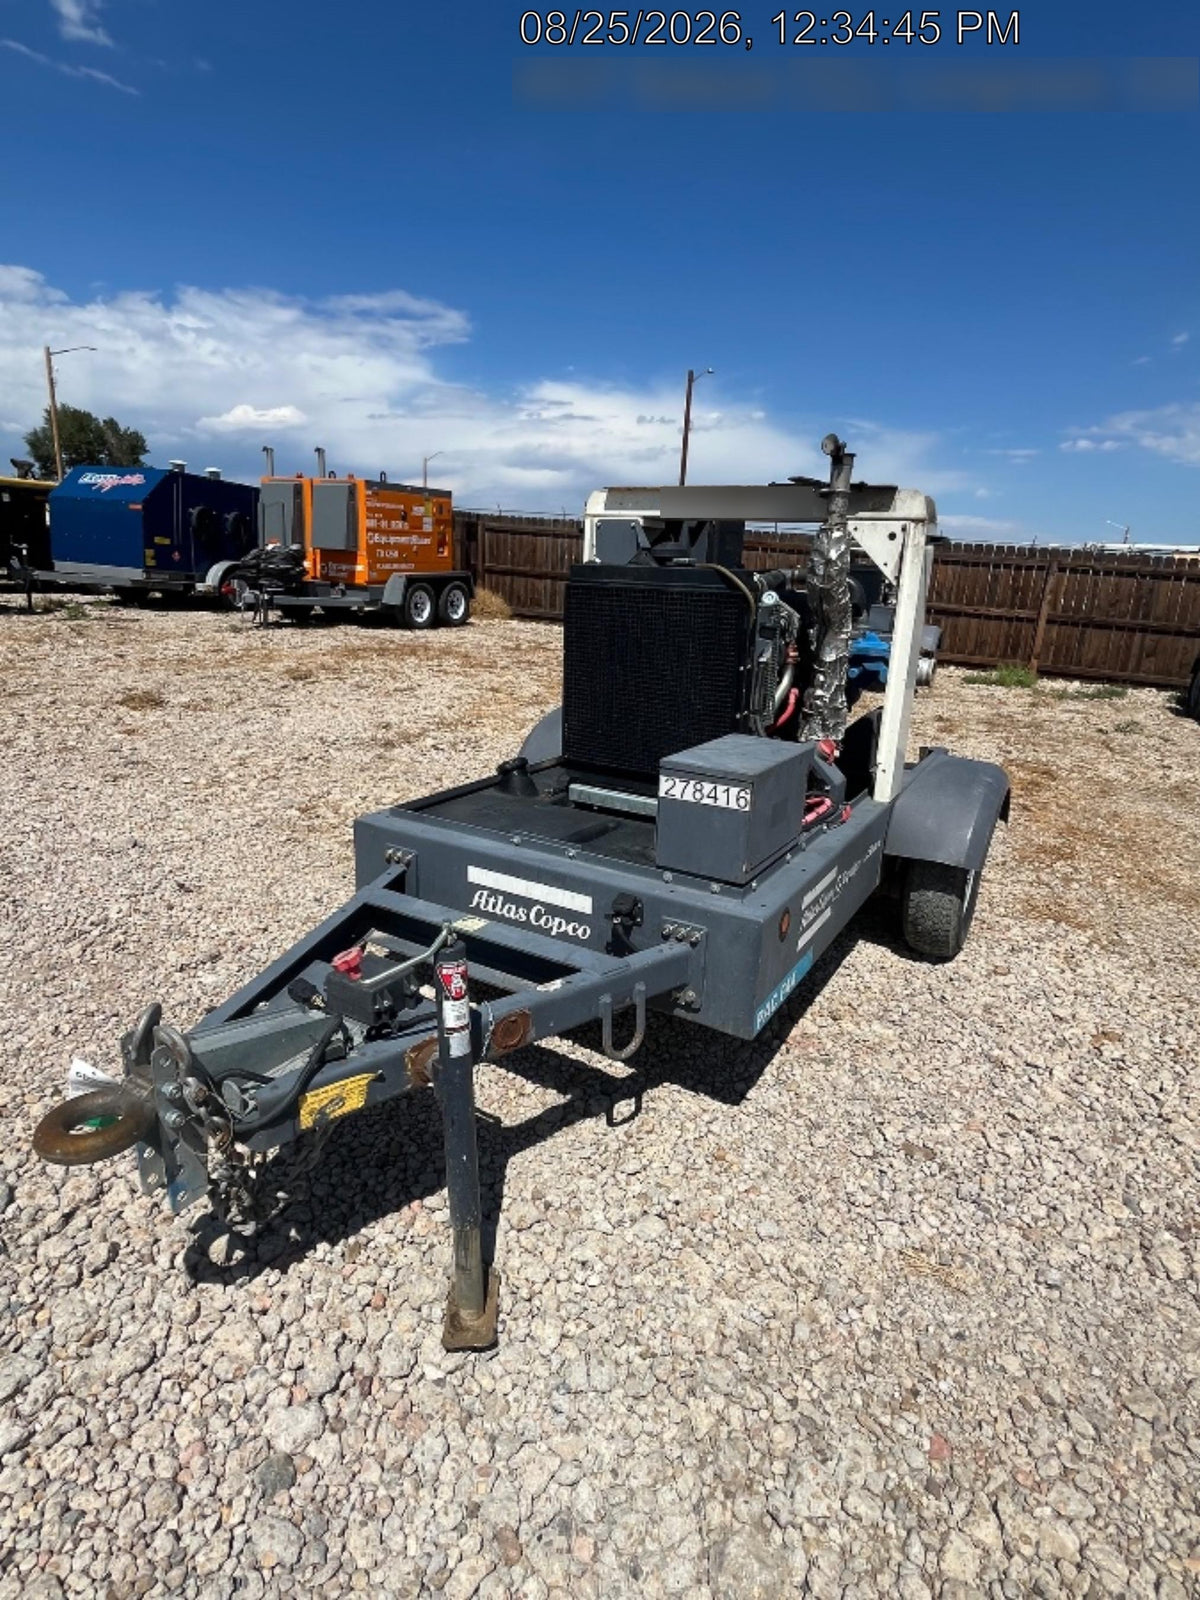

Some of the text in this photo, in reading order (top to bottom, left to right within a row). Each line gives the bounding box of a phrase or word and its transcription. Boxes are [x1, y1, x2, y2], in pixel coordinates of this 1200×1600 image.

[664, 777, 750, 809] 278416
[468, 890, 591, 939] Atlas Copco
